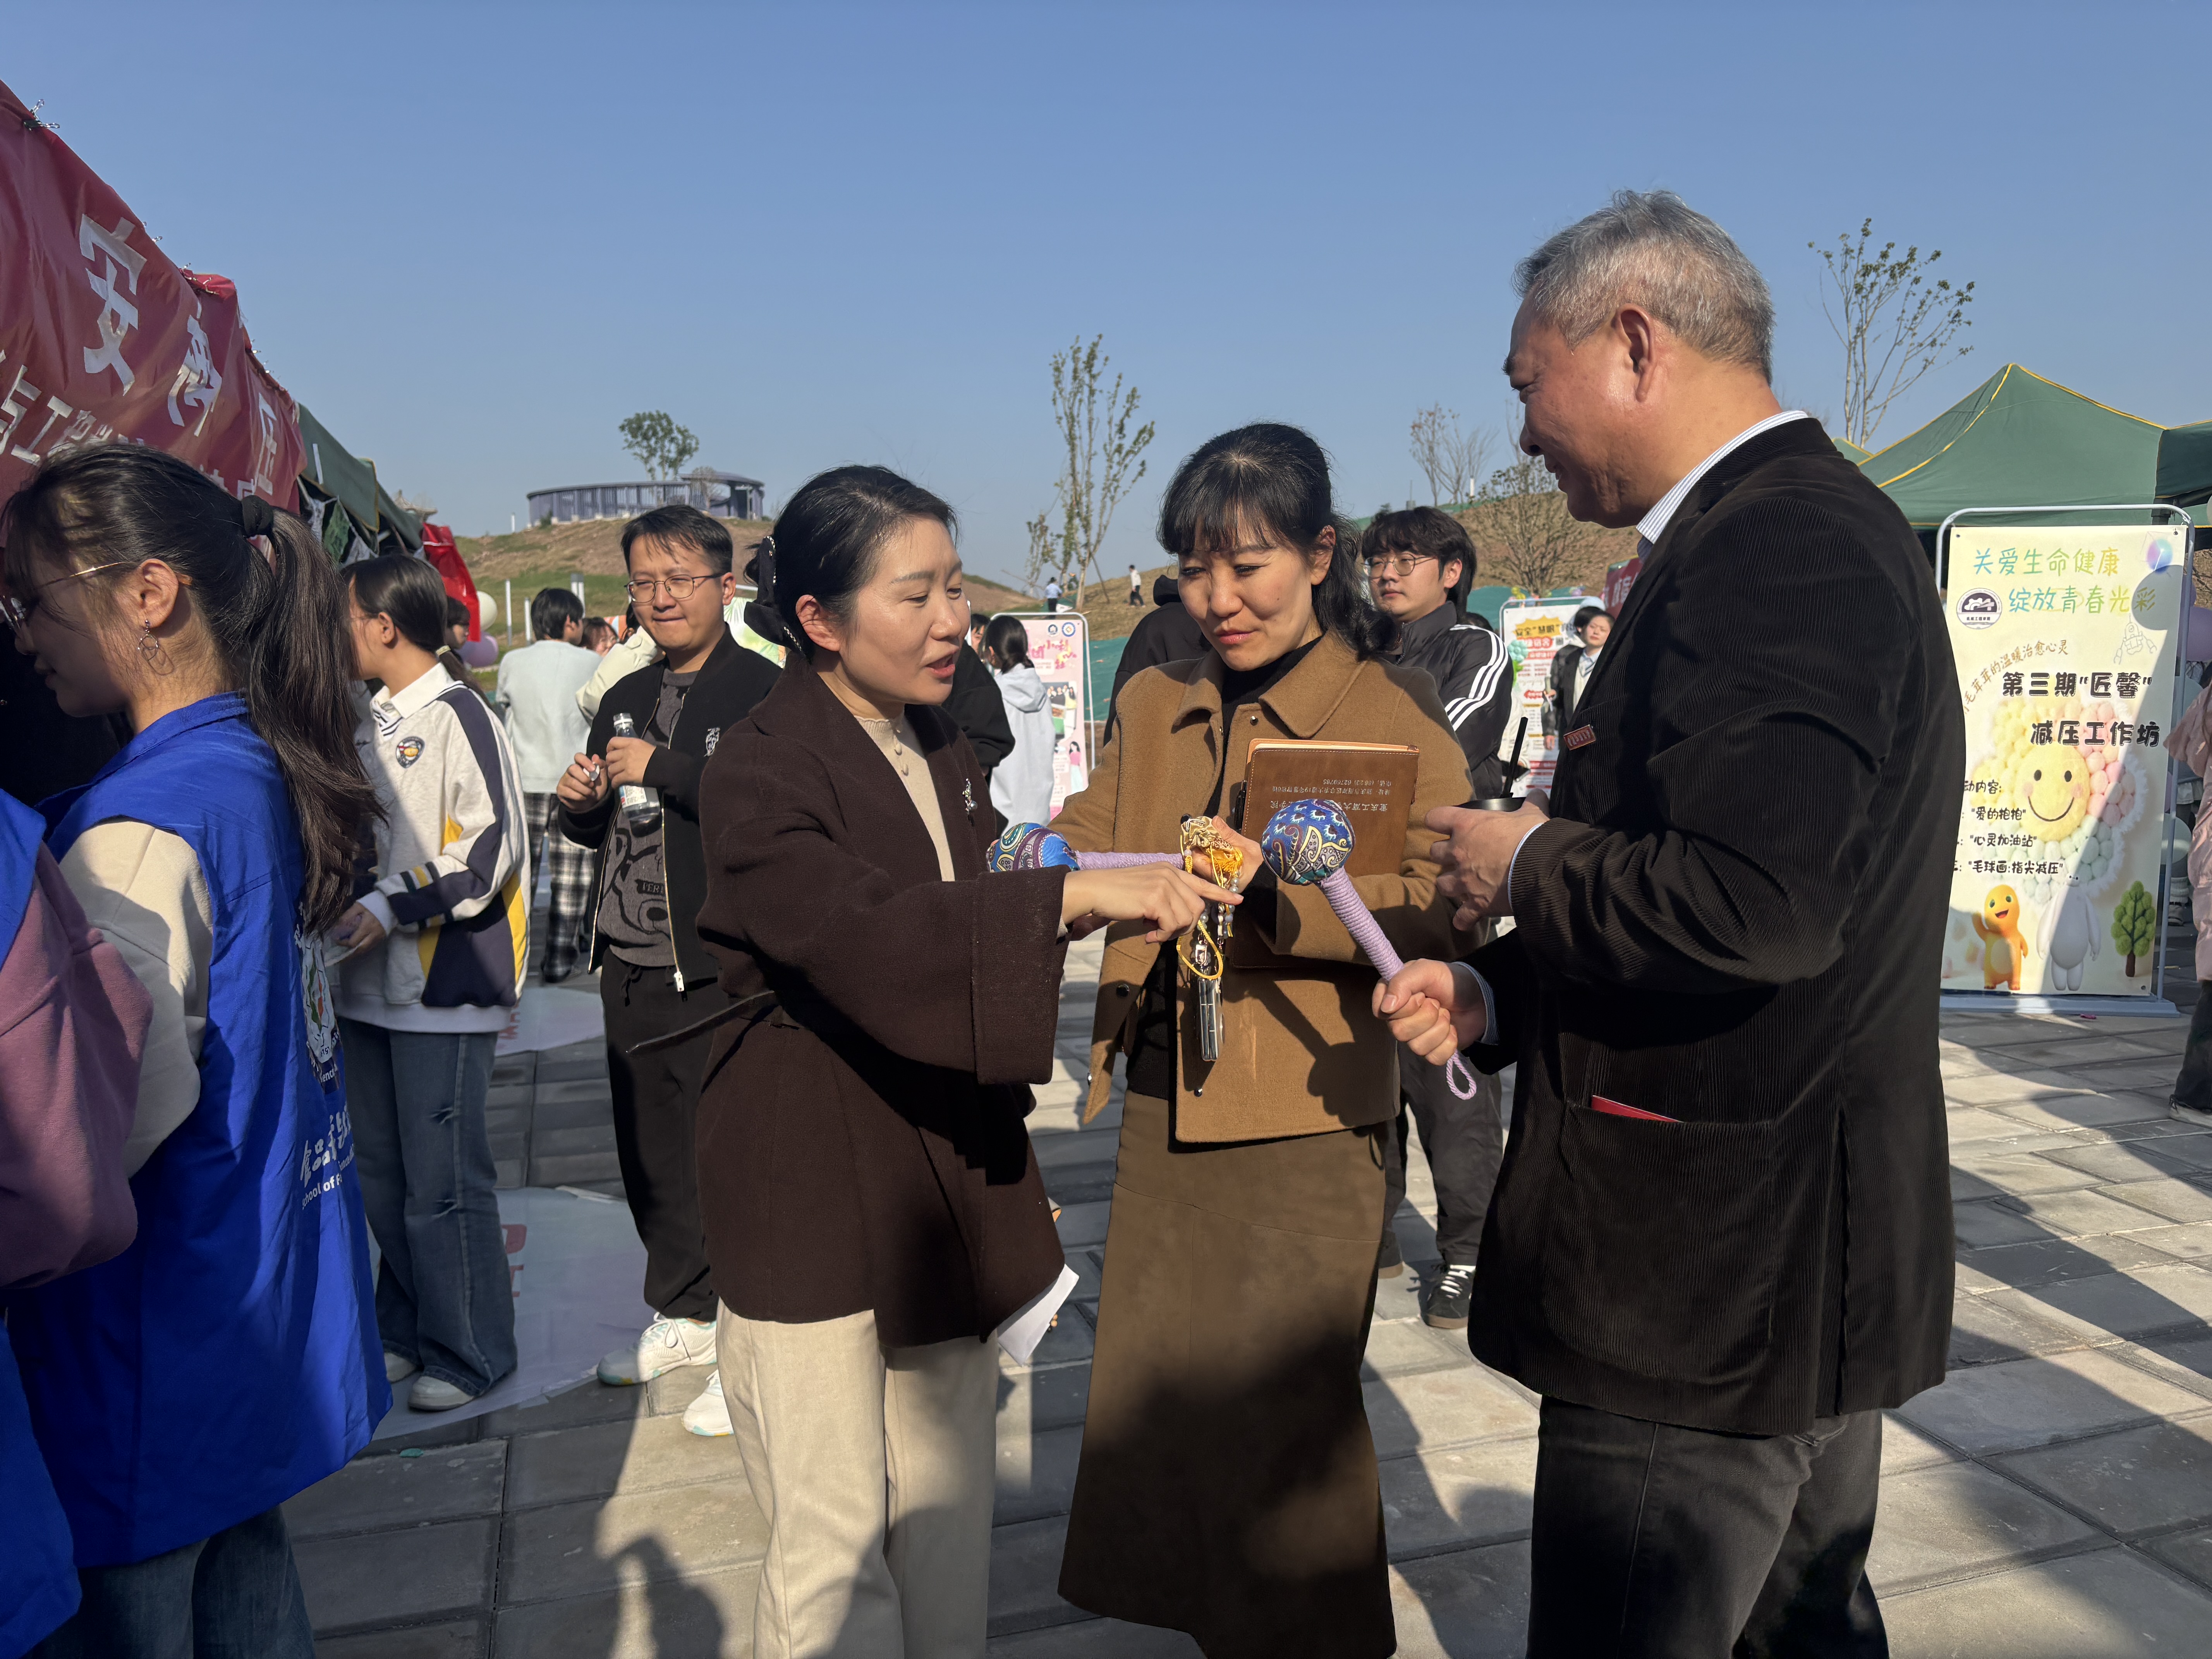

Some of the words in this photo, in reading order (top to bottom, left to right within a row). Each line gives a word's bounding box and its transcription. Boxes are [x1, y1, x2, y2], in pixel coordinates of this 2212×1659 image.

[1973, 547, 2120, 577] 关爱生命健康
[2008, 585, 2156, 614] 绽放青春光彩
[2002, 672, 2152, 698] 第三期"匠馨"
[2030, 720, 2160, 747] 减压工作坊
[323, 1175, 335, 1192] of
